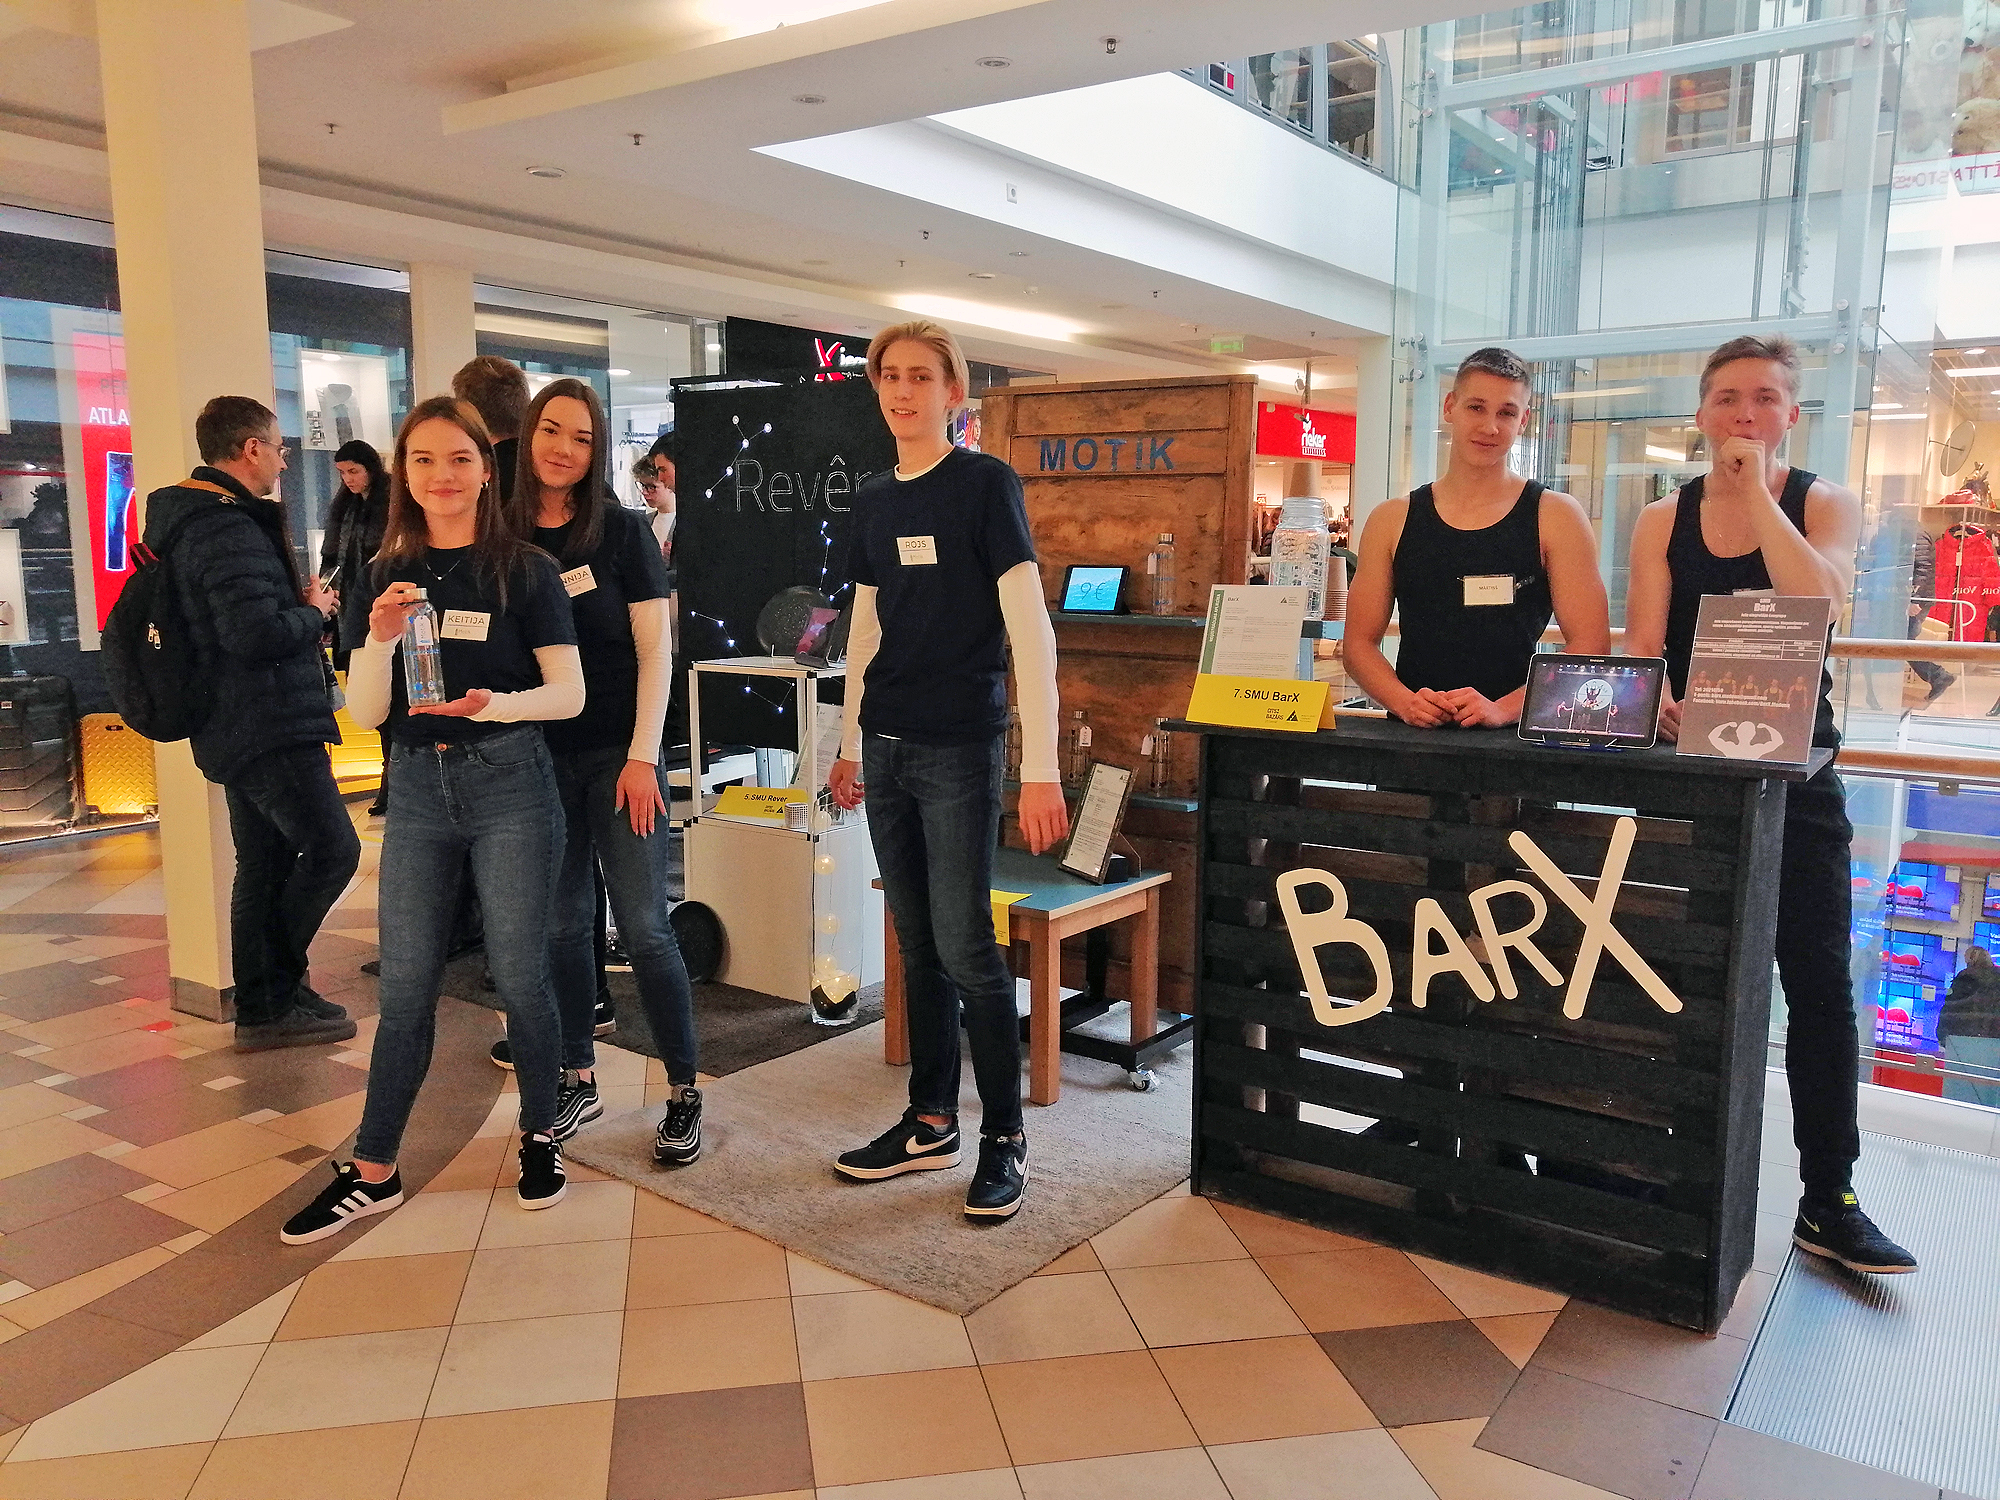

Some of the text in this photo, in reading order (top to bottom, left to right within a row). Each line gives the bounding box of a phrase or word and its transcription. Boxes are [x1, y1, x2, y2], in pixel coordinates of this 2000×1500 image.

[1039, 437, 1175, 473] MOTIK
[904, 540, 927, 549] ROJS
[1753, 603, 1776, 612] BarX
[447, 615, 485, 625] KEITIJA
[1244, 689, 1269, 700] SMU
[1272, 691, 1301, 703] BarX
[750, 793, 767, 802] SMU
